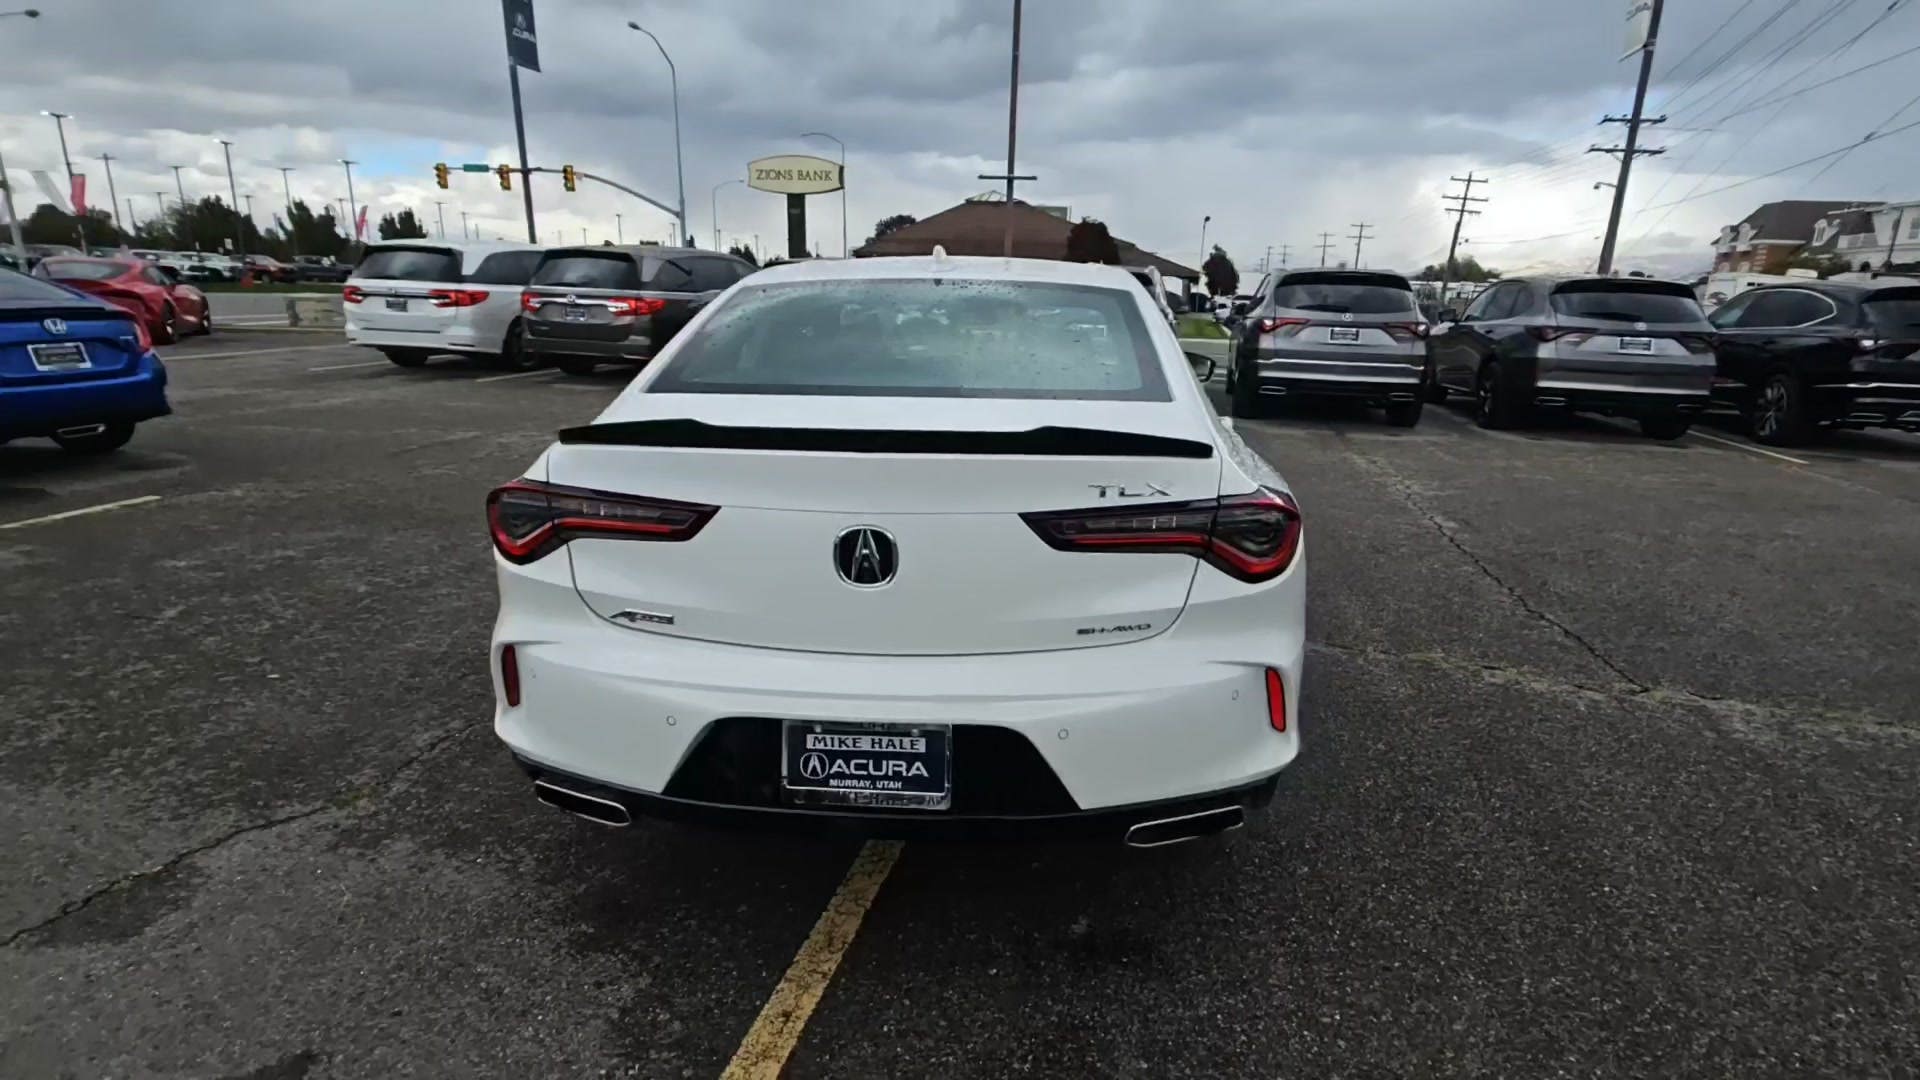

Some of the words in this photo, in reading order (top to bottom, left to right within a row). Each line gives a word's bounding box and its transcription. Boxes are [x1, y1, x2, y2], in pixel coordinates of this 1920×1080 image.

[755, 168, 793, 181] ZIONS
[797, 169, 833, 182] BANK
[1087, 481, 1173, 498] TLX
[812, 735, 862, 749] MIKE
[871, 737, 921, 751] HALE
[830, 759, 929, 777] ACURA
[829, 779, 874, 789] MURRAY,
[876, 780, 903, 790] UTAH
